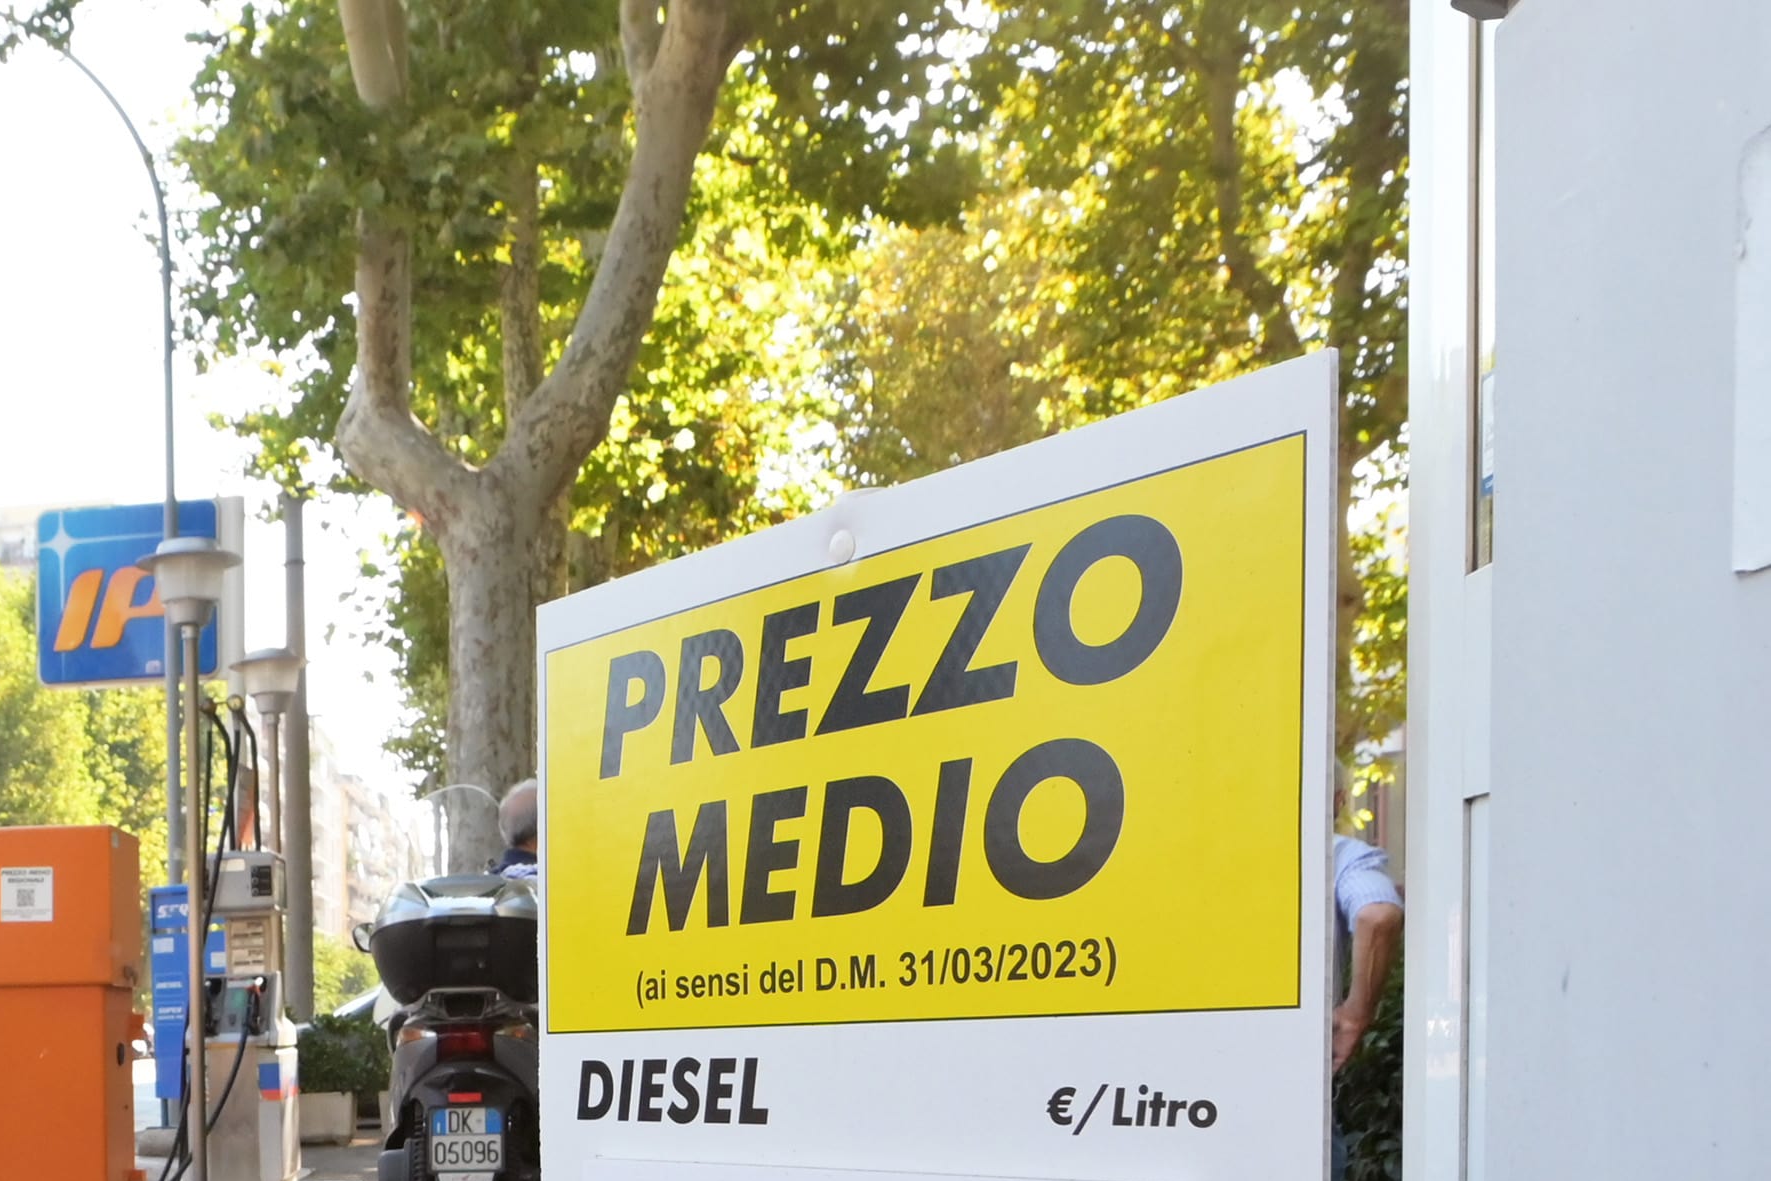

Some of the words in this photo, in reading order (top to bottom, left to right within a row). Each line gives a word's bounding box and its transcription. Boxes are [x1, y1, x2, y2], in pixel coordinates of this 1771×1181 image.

[53, 565, 167, 653] IP
[599, 514, 1183, 780] PREZZO
[626, 737, 1125, 936] MEDIO
[636, 966, 666, 1009] (ai
[675, 964, 748, 999] sensi
[760, 958, 803, 994] del
[816, 952, 887, 991] D.M.
[898, 936, 1117, 987] 31/03/2023)
[449, 1110, 473, 1133] DK
[577, 1057, 769, 1125] DIESEL
[1046, 1084, 1217, 1136] €/Litro
[434, 1140, 499, 1165] 05096
